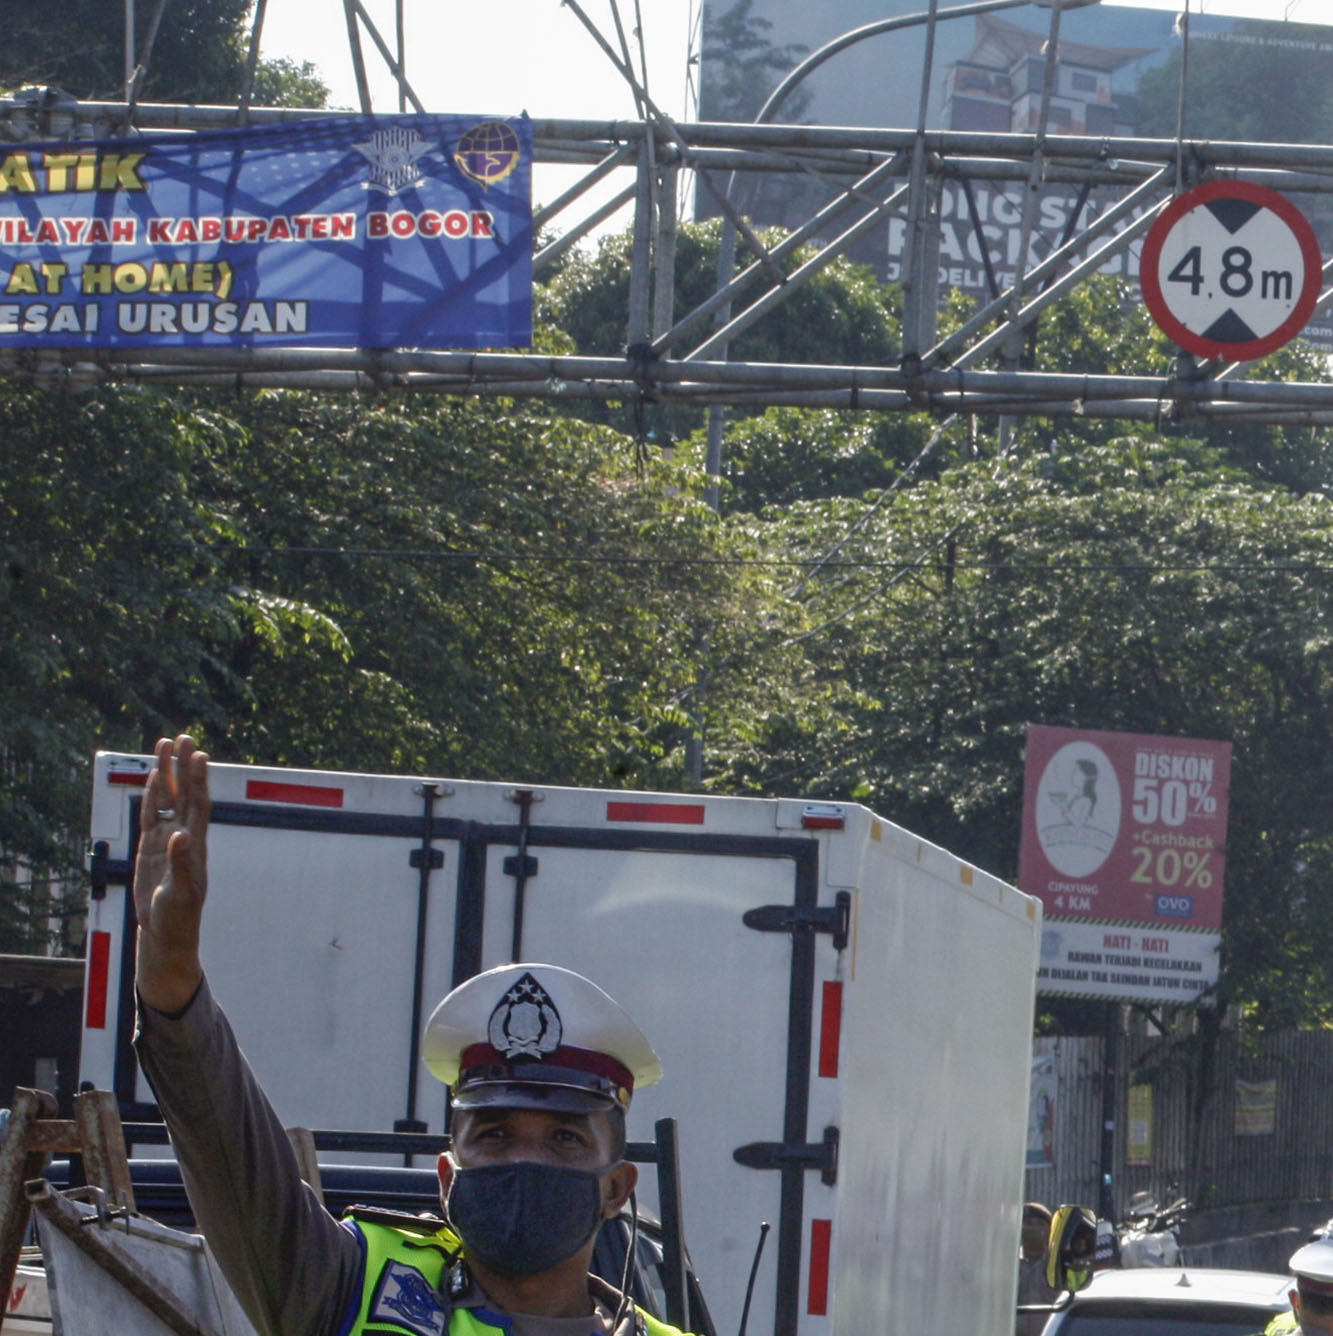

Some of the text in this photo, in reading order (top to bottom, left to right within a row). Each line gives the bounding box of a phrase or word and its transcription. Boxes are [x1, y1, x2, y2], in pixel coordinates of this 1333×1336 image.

[147, 211, 356, 245] KABUPATEN
[367, 210, 495, 239] BOGOR
[5, 259, 235, 299] AT HOME)
[117, 301, 308, 334] URUSAN
[1134, 751, 1215, 782] DISKON
[1131, 778, 1217, 827] 50%
[1129, 847, 1213, 890] 20%
[1069, 896, 1091, 910] KM
[1158, 895, 1190, 910] OVO
